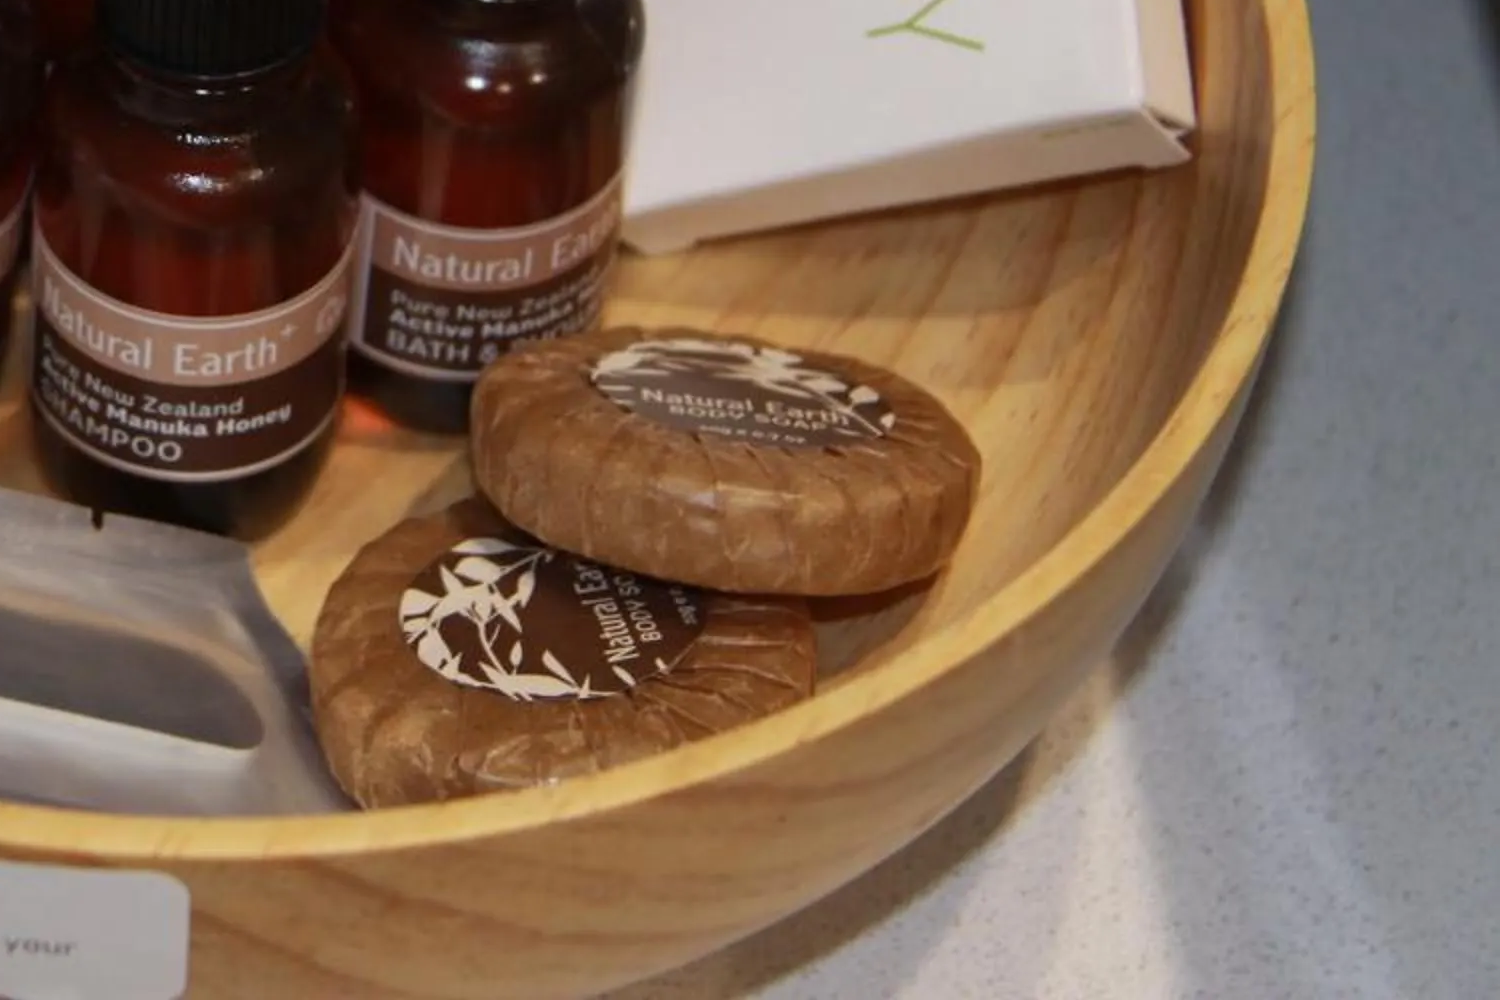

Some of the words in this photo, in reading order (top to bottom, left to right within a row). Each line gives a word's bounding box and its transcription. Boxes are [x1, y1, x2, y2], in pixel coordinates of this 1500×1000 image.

[393, 234, 534, 285] Natural
[389, 308, 475, 338] Active
[390, 289, 451, 319] Pure
[456, 303, 513, 322] New
[386, 327, 471, 363] BATH
[84, 371, 135, 408] New
[141, 394, 245, 421] Zealand
[640, 387, 754, 413] Natural
[764, 400, 849, 427] Earth
[668, 404, 746, 421] BODY
[106, 403, 208, 438] Manuka
[216, 404, 292, 437] Honey
[579, 596, 641, 663] Natural
[623, 599, 664, 643] BODY
[3, 937, 77, 959] your
